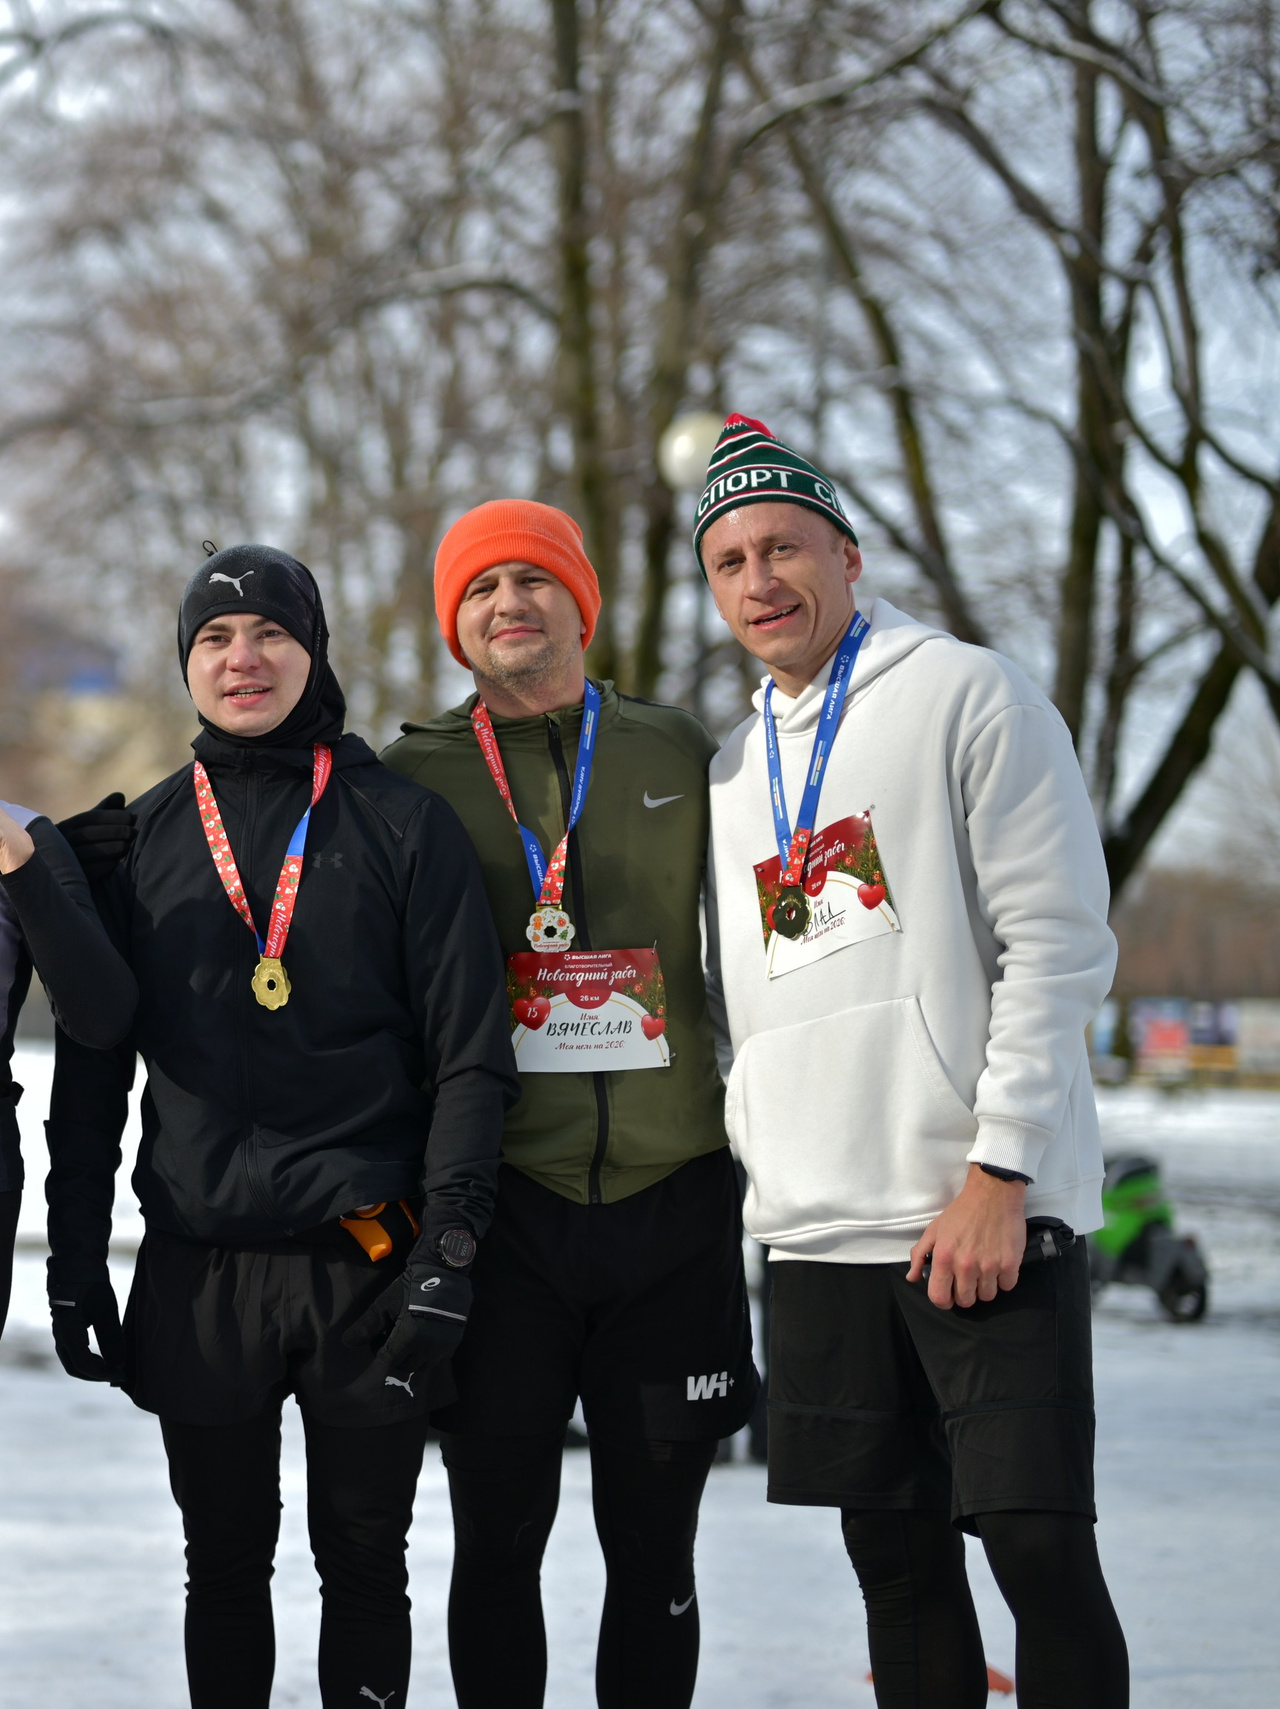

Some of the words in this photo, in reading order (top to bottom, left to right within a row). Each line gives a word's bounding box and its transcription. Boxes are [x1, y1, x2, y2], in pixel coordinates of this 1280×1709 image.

[697, 469, 793, 518] СПОРТ
[832, 664, 845, 699] ВЫСШАЯ
[826, 699, 836, 720] ЛИГА
[536, 967, 608, 988] Новогодний
[608, 965, 637, 986] забег
[527, 1006, 539, 1018] 15
[546, 1020, 633, 1037] ВЯЧЕСЛАВ
